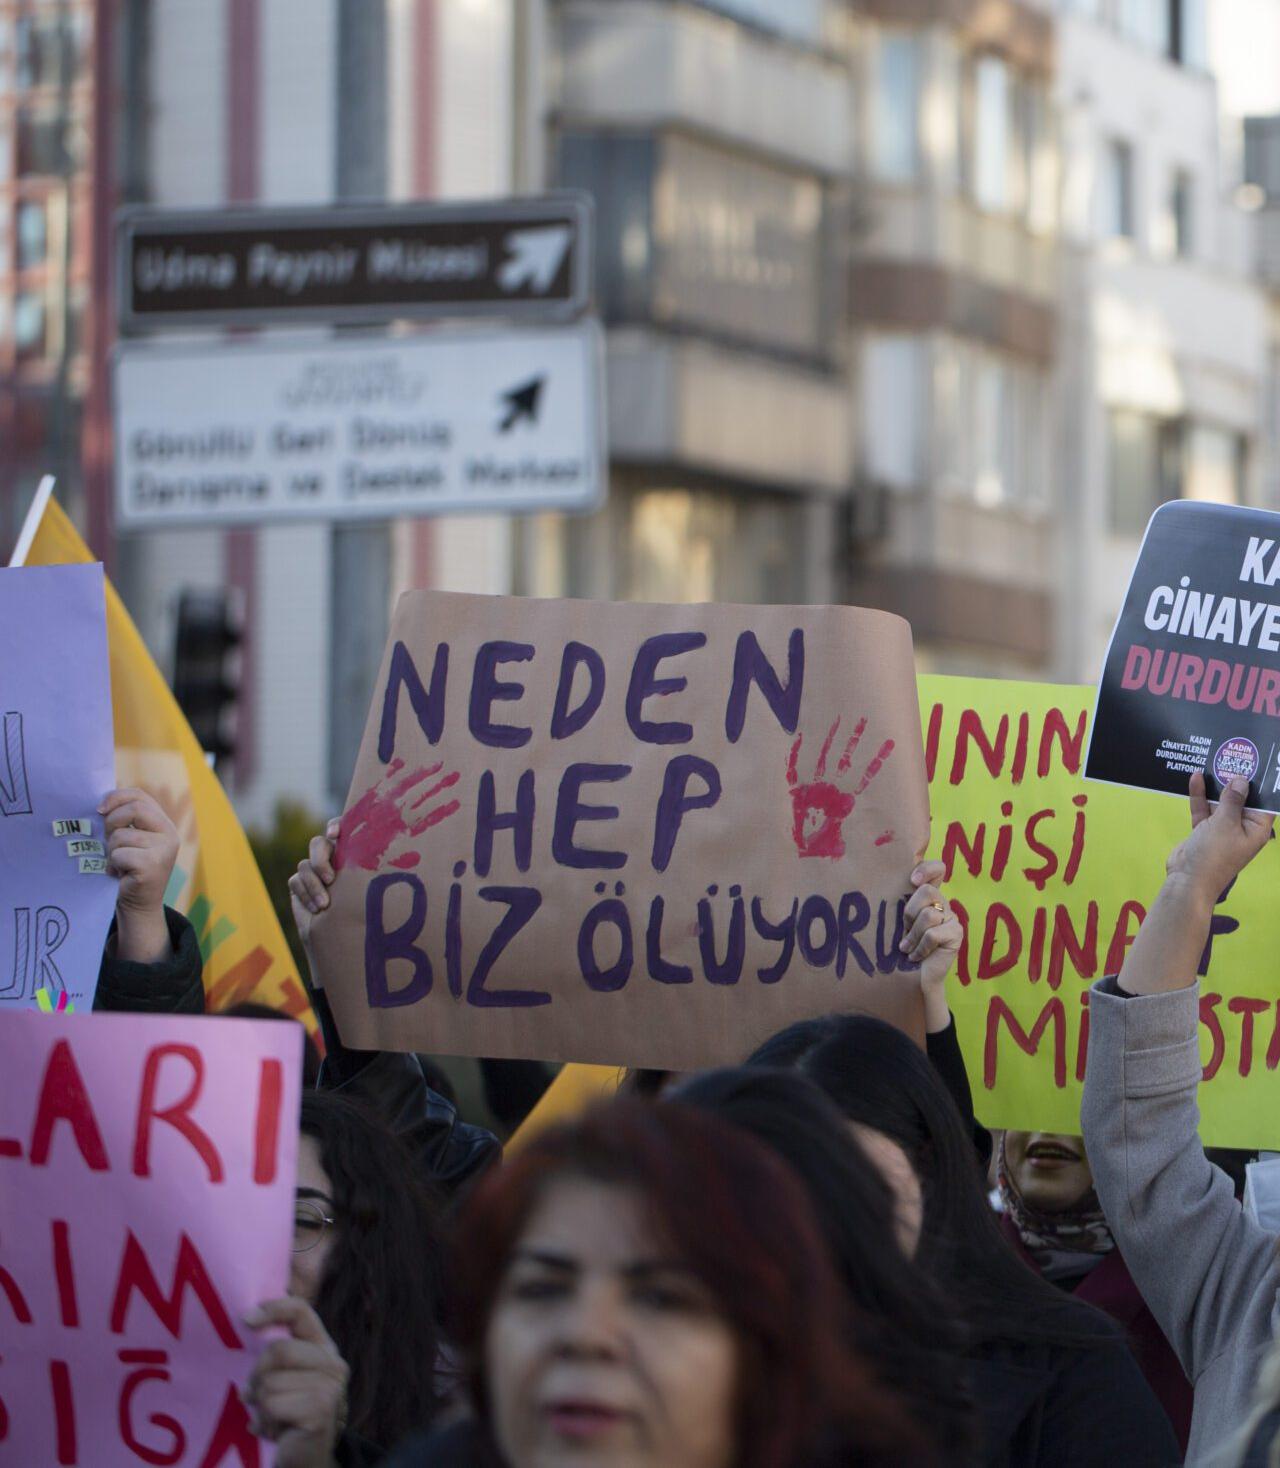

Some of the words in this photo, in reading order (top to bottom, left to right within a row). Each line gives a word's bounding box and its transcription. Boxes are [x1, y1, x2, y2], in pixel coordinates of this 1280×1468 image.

[248, 242, 358, 295] Peynir
[378, 628, 804, 764] NEDEN
[1190, 735, 1212, 746] KADIN
[1156, 749, 1208, 766] DURDURACAĞIZ
[1161, 739, 1210, 756] CİNAYETLERİNİ
[56, 820, 82, 835] JIN
[474, 754, 722, 878] HEP
[929, 794, 1088, 892] NİŞİ
[365, 860, 552, 1008] BİZ
[578, 880, 922, 992] ÖLÜYORU
[0, 1037, 283, 1185] ARI
[0, 1218, 246, 1350] IM
